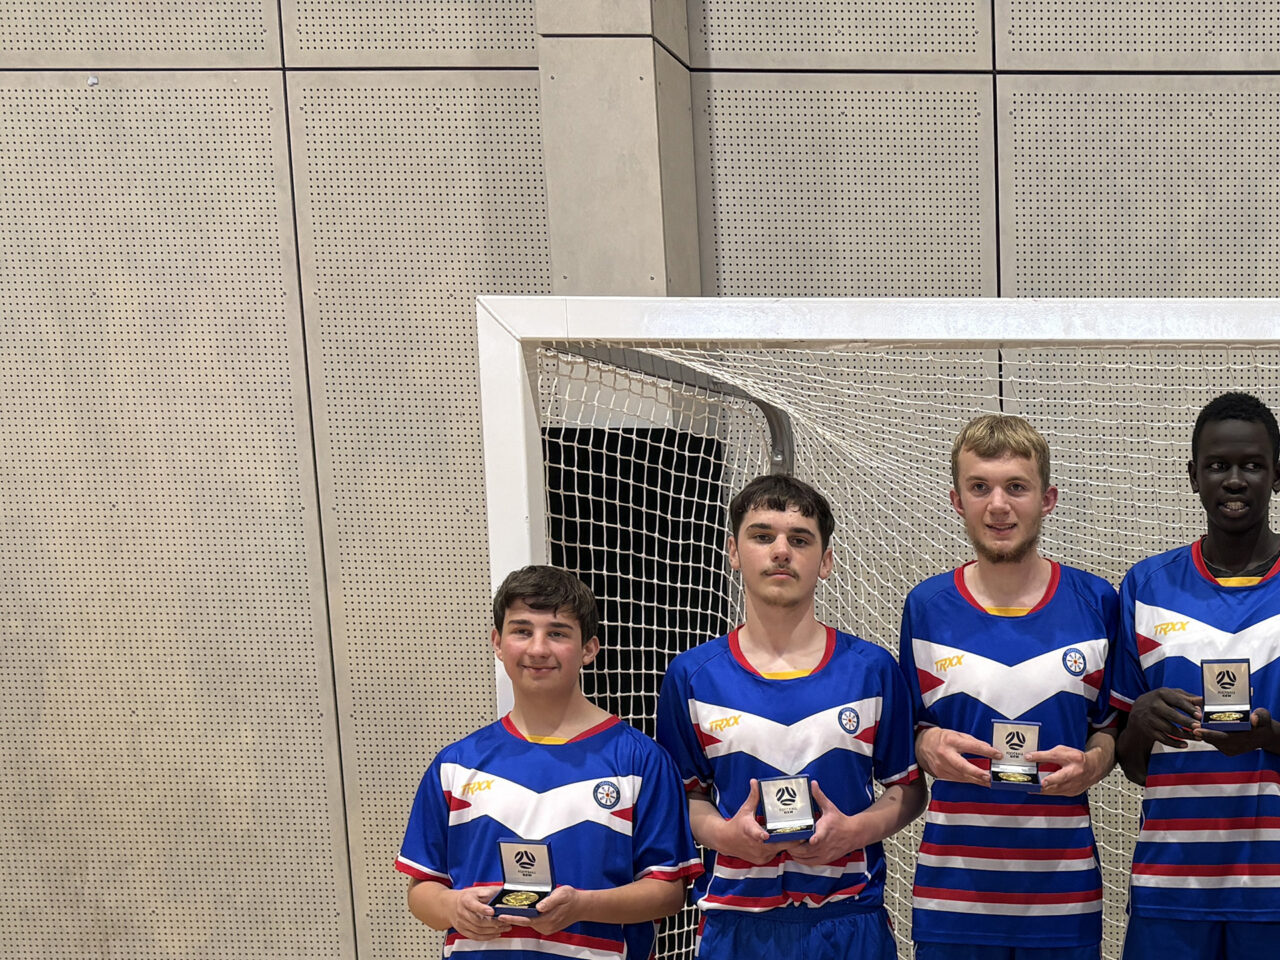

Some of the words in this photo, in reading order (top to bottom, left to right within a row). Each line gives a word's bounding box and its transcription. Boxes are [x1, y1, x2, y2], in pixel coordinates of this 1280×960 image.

[1154, 621, 1190, 636] TRXX
[935, 655, 965, 672] TRXX
[709, 714, 742, 732] TRXX
[461, 779, 496, 796] TRXX
